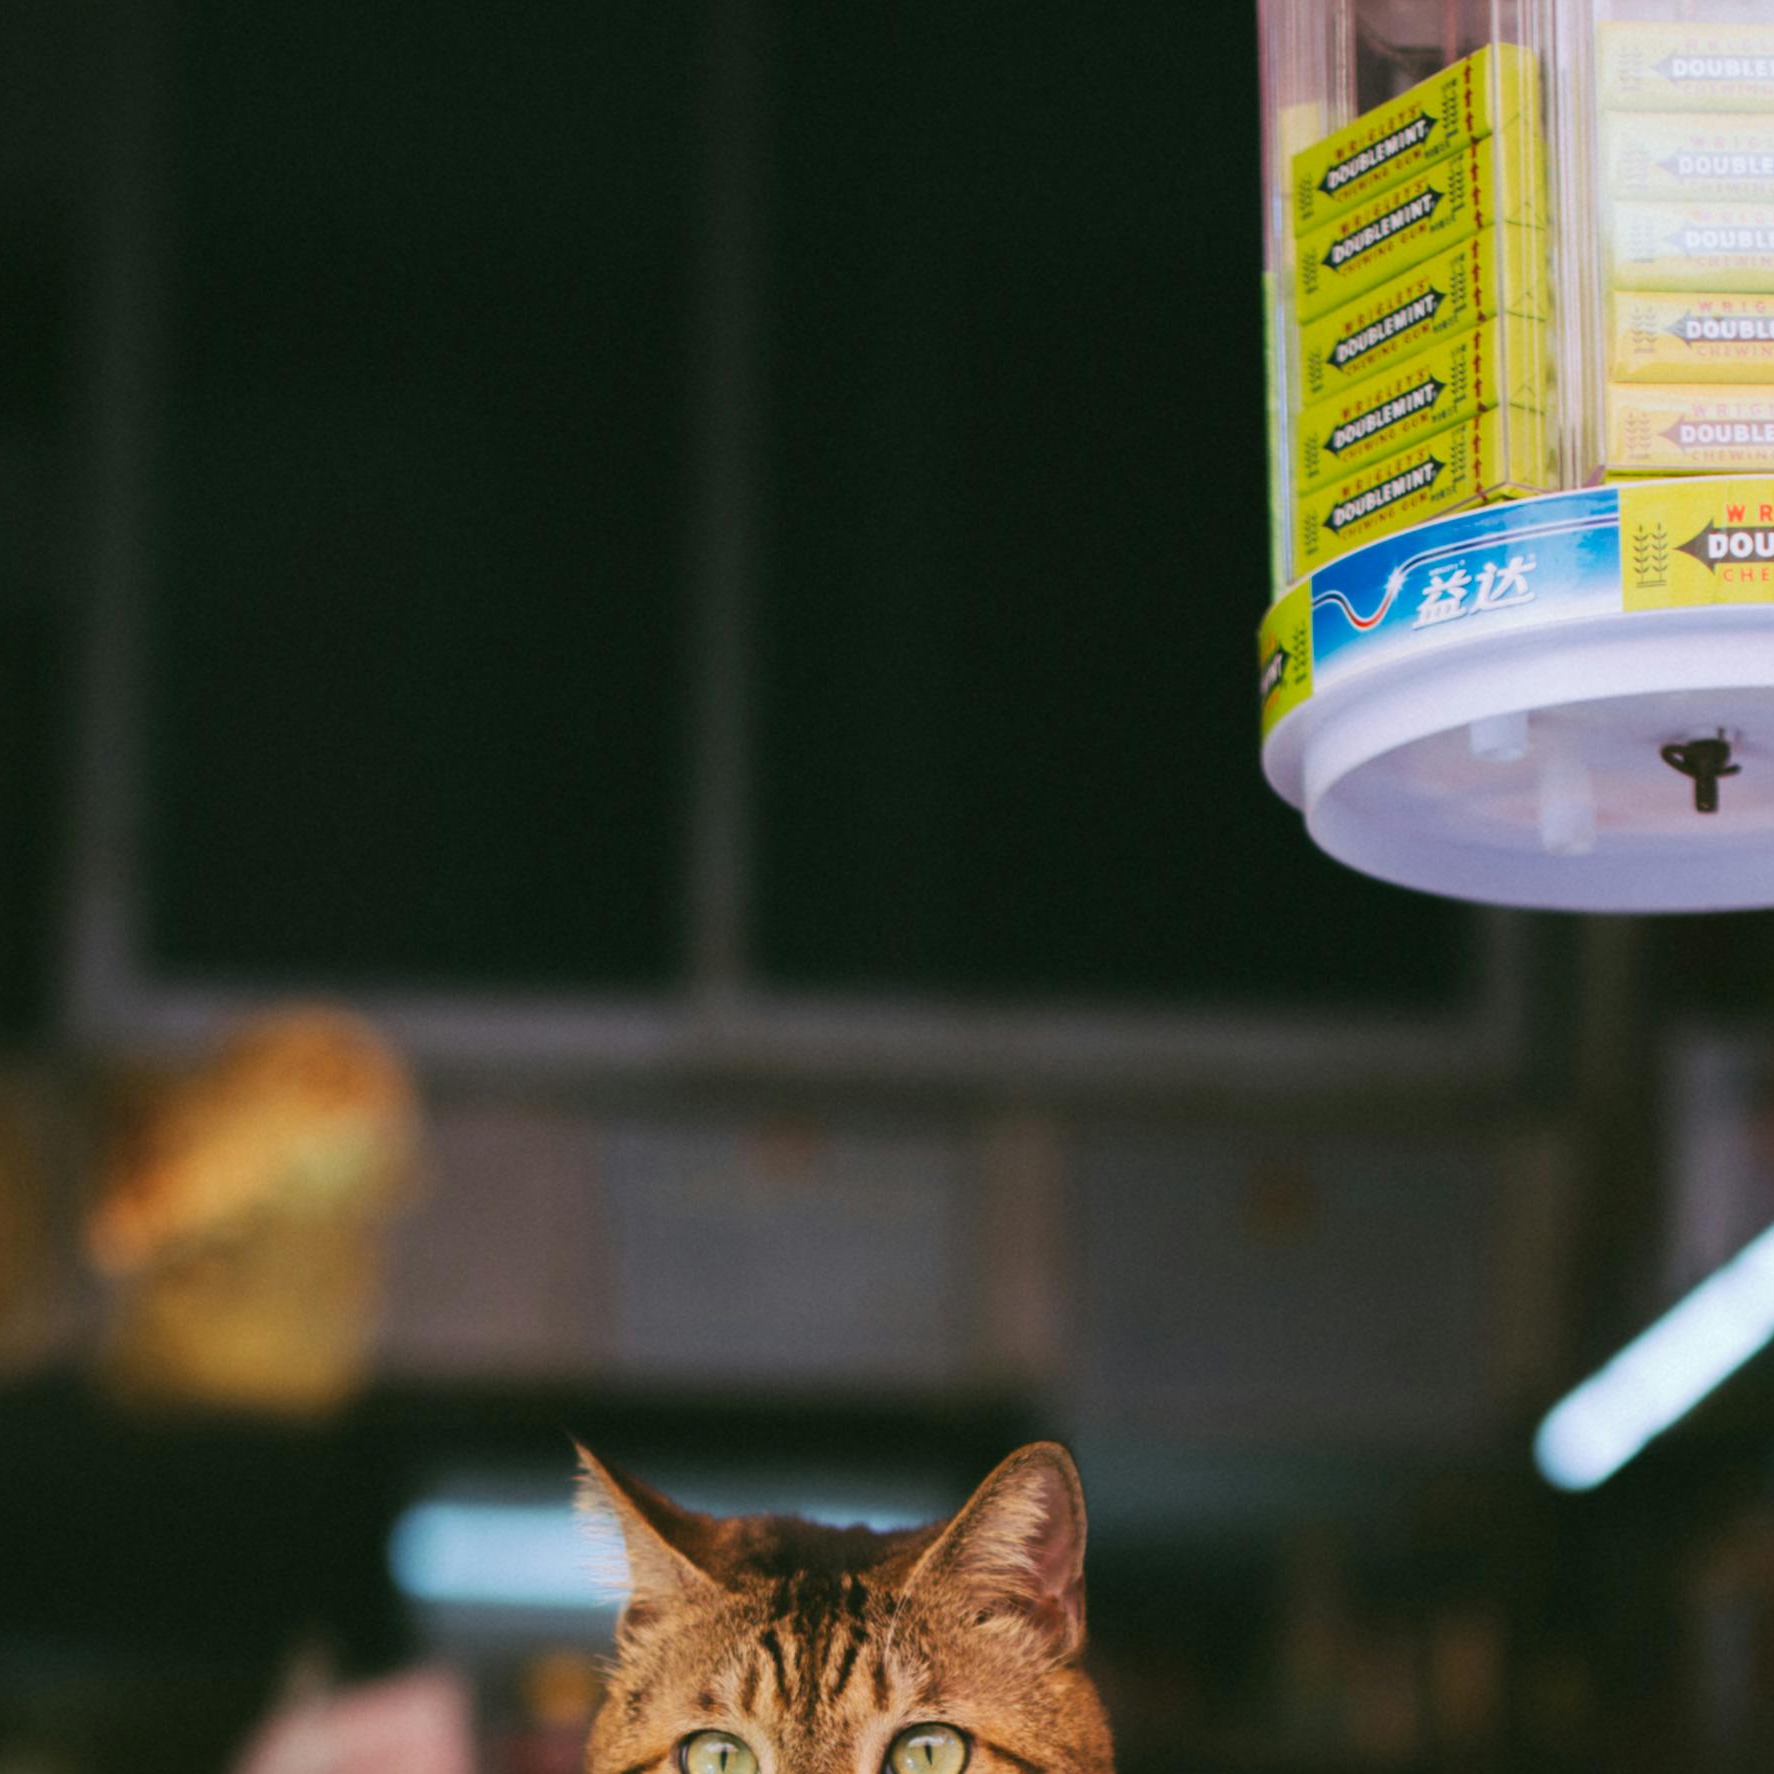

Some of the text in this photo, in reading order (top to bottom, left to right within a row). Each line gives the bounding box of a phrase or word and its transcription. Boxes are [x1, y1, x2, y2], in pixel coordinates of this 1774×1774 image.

[1328, 119, 1427, 189] DOUBLEMINT
[1332, 193, 1433, 264] DOUBLEMINT
[1336, 293, 1435, 363] DOUBLEMINT
[1333, 383, 1435, 449] DOUBLEMINT
[1333, 462, 1435, 528] DOUBLEMINT
[1411, 555, 1538, 630] 益达
